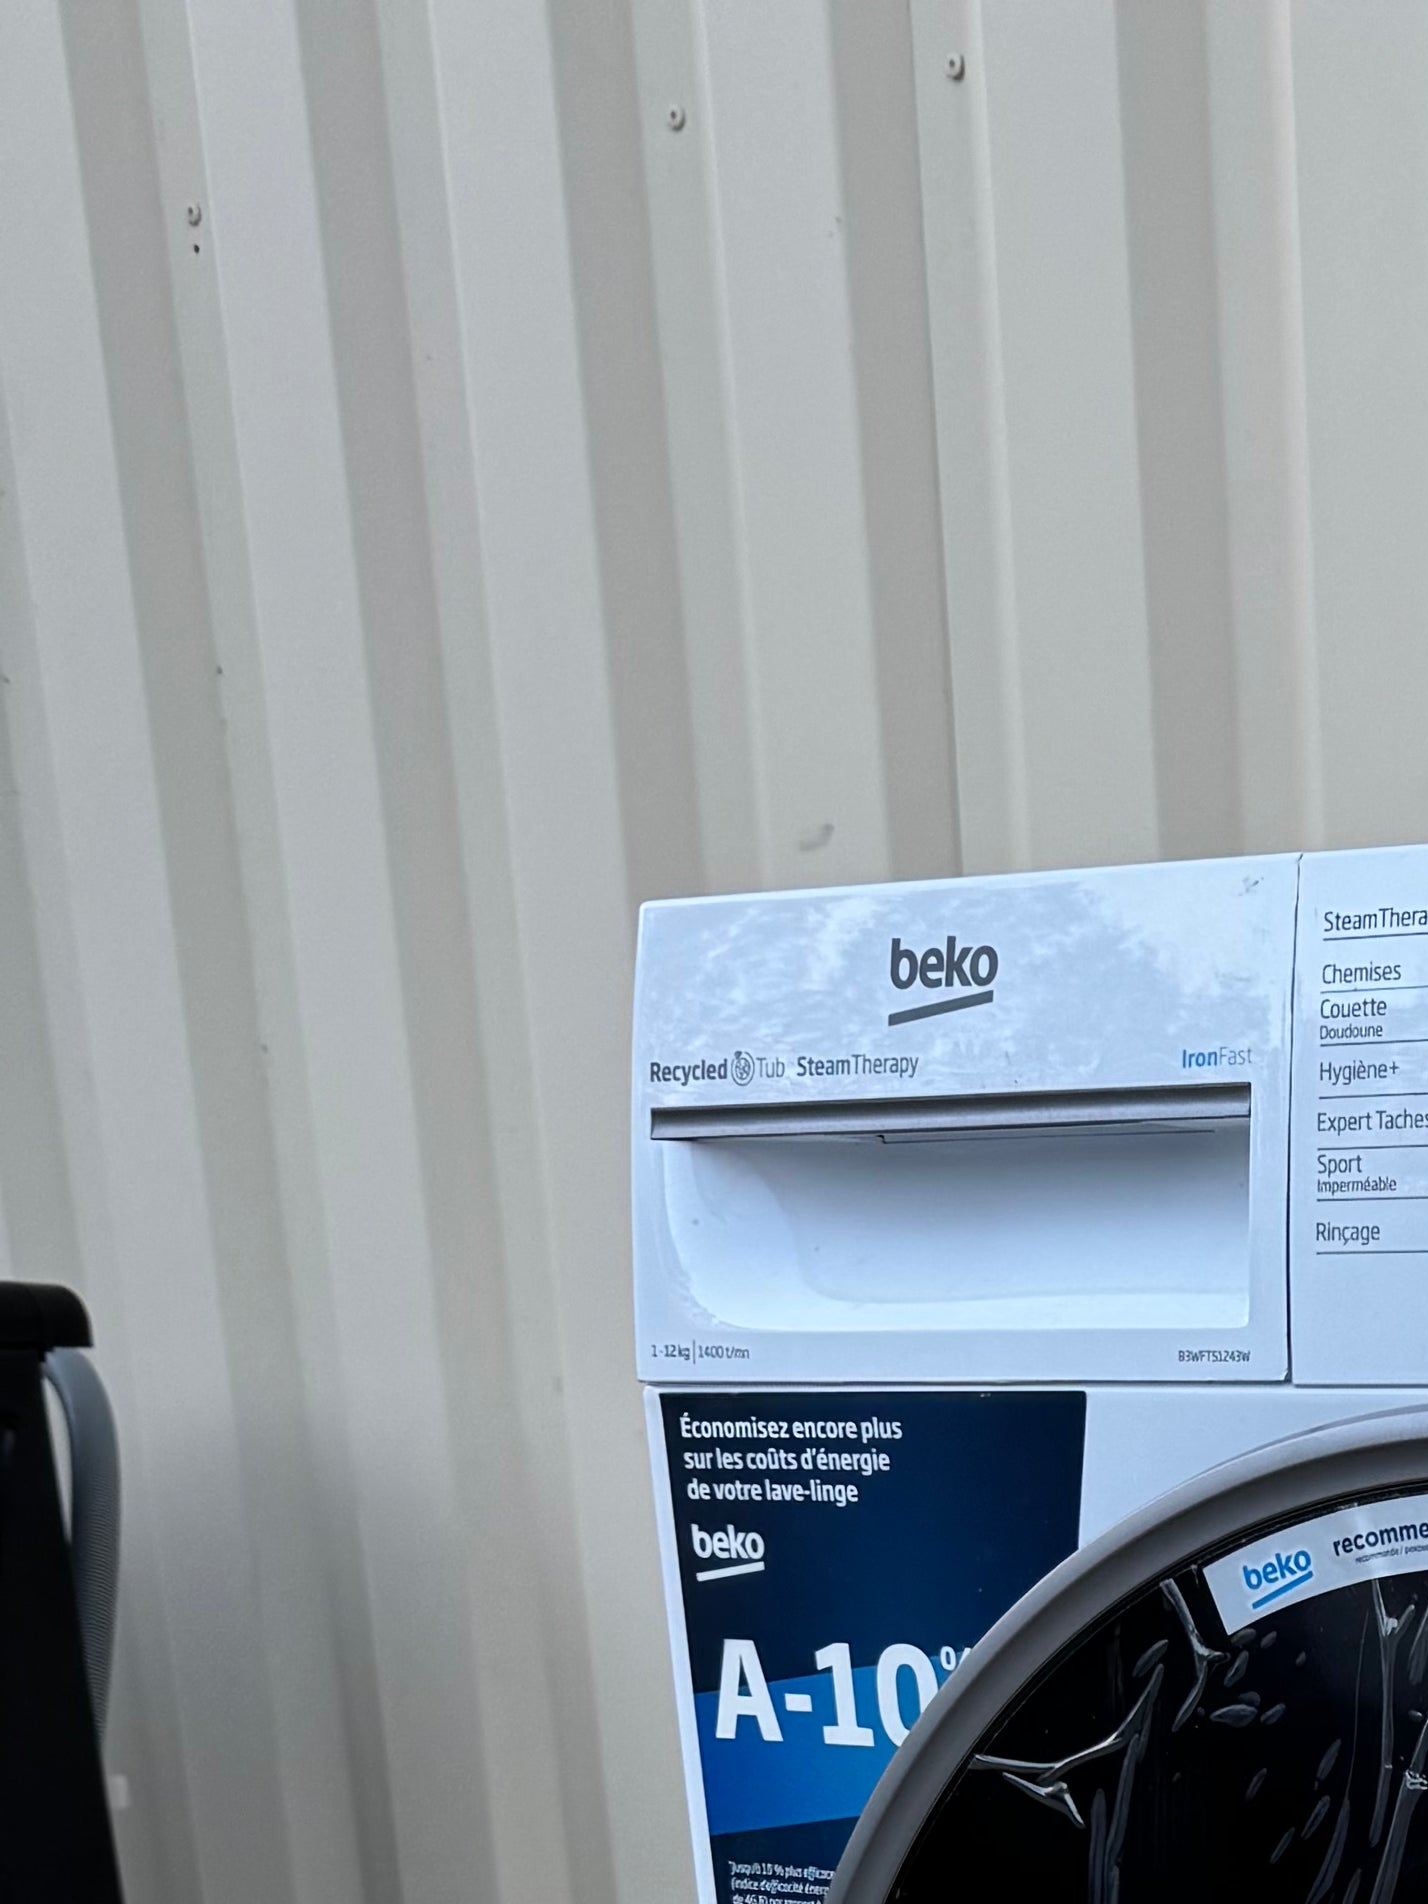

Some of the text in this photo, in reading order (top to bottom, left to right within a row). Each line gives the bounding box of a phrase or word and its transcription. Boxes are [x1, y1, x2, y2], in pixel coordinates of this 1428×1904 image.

[890, 935, 999, 989] beko
[1322, 961, 1402, 985] Chemises
[1320, 997, 1388, 1020] Couette
[1319, 1023, 1384, 1041] Doudoune
[796, 1054, 919, 1079] SteamTherapy
[1182, 1046, 1252, 1069] IronFast
[650, 1056, 786, 1087] Recycled Tub
[1319, 1059, 1400, 1086] Hygiène+
[1317, 1111, 1373, 1137] Expert
[1317, 1153, 1363, 1176] Sport
[1317, 1176, 1398, 1195] Imperméable
[1315, 1221, 1381, 1246] Rinçage
[679, 1411, 903, 1444] Économisez encore plus
[683, 1447, 891, 1476] sur les coûts d'énergie
[687, 1477, 859, 1508] de votre lave-linge
[690, 1523, 765, 1560] beko
[1242, 1546, 1313, 1591] beko
